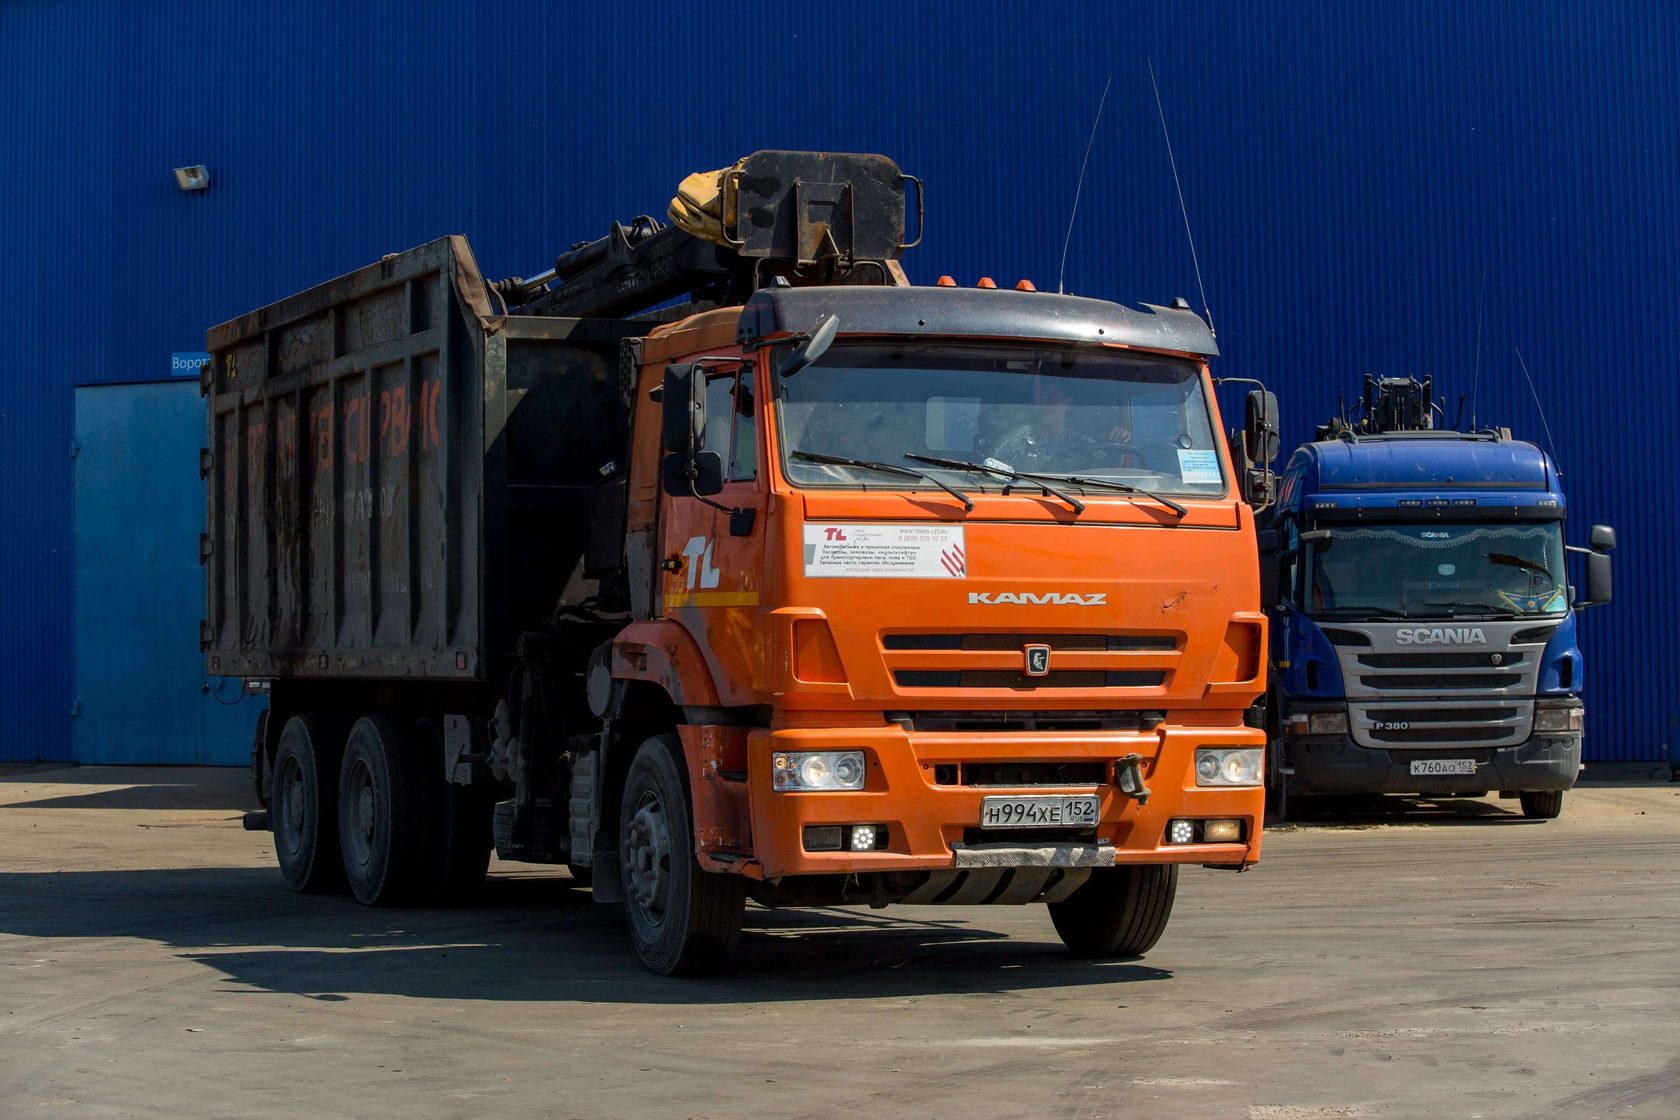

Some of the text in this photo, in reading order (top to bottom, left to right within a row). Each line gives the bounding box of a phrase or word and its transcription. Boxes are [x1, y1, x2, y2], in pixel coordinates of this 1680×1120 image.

[823, 527, 847, 541] TL
[682, 536, 720, 590] TL
[968, 592, 1107, 605] KAMAZ
[1395, 628, 1487, 645] SCANIA
[1065, 801, 1092, 816] 152
